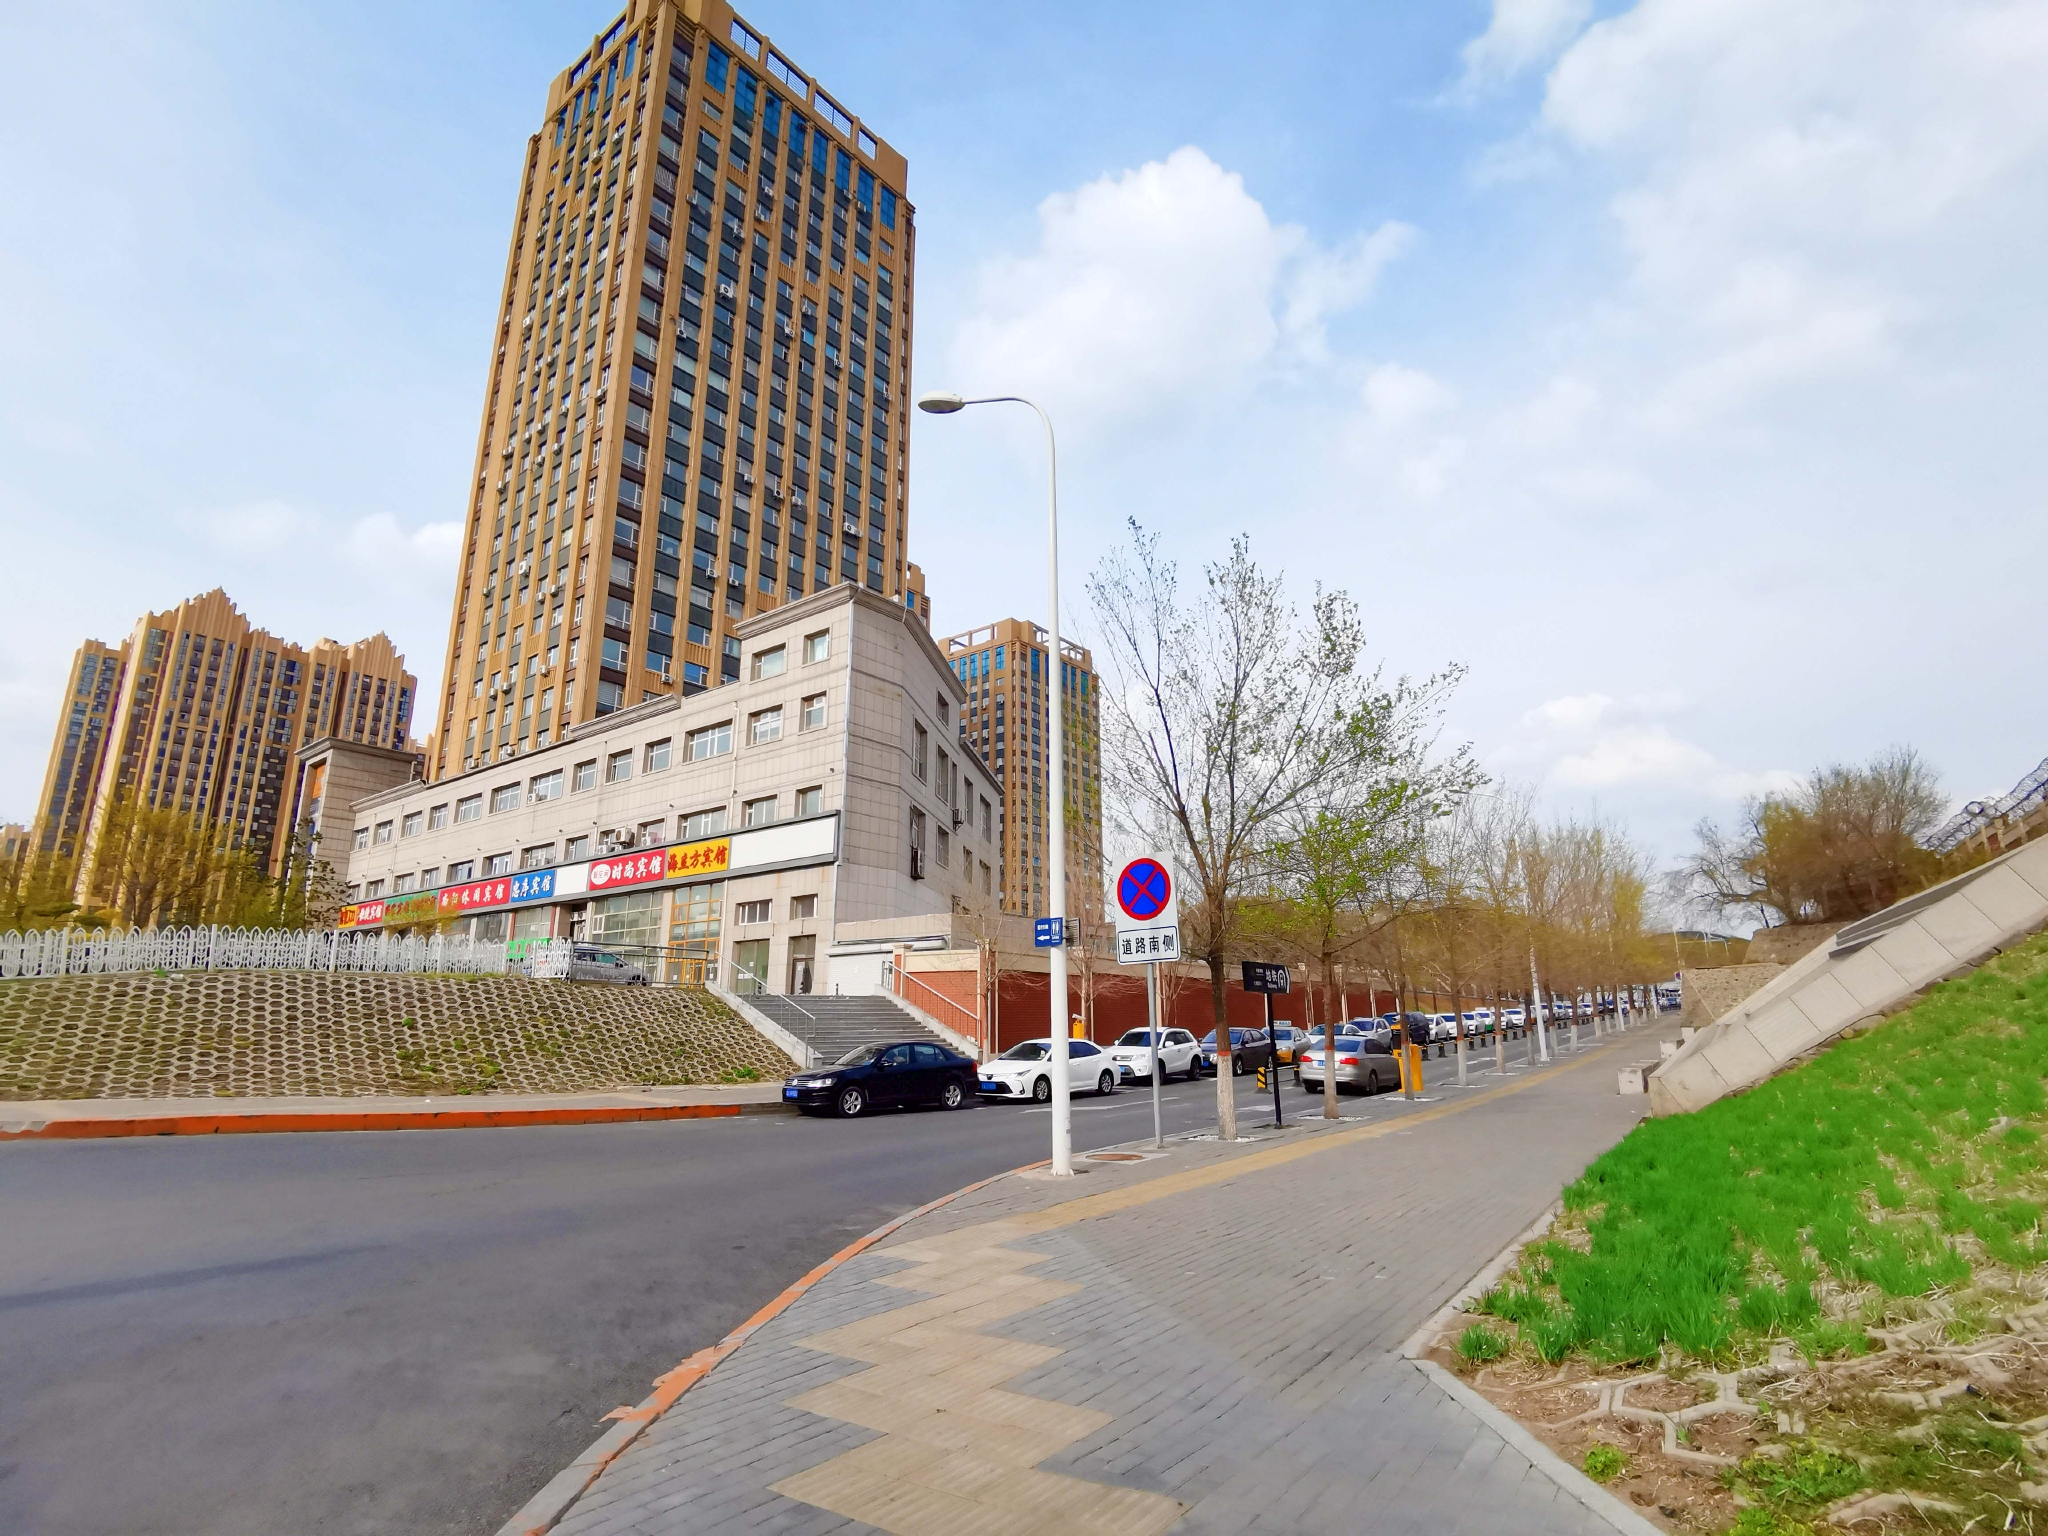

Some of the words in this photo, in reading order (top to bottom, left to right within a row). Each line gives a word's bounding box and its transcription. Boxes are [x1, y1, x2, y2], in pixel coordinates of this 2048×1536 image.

[611, 855, 663, 880] 时尚宾馆
[1121, 933, 1175, 955] 道路南侧
